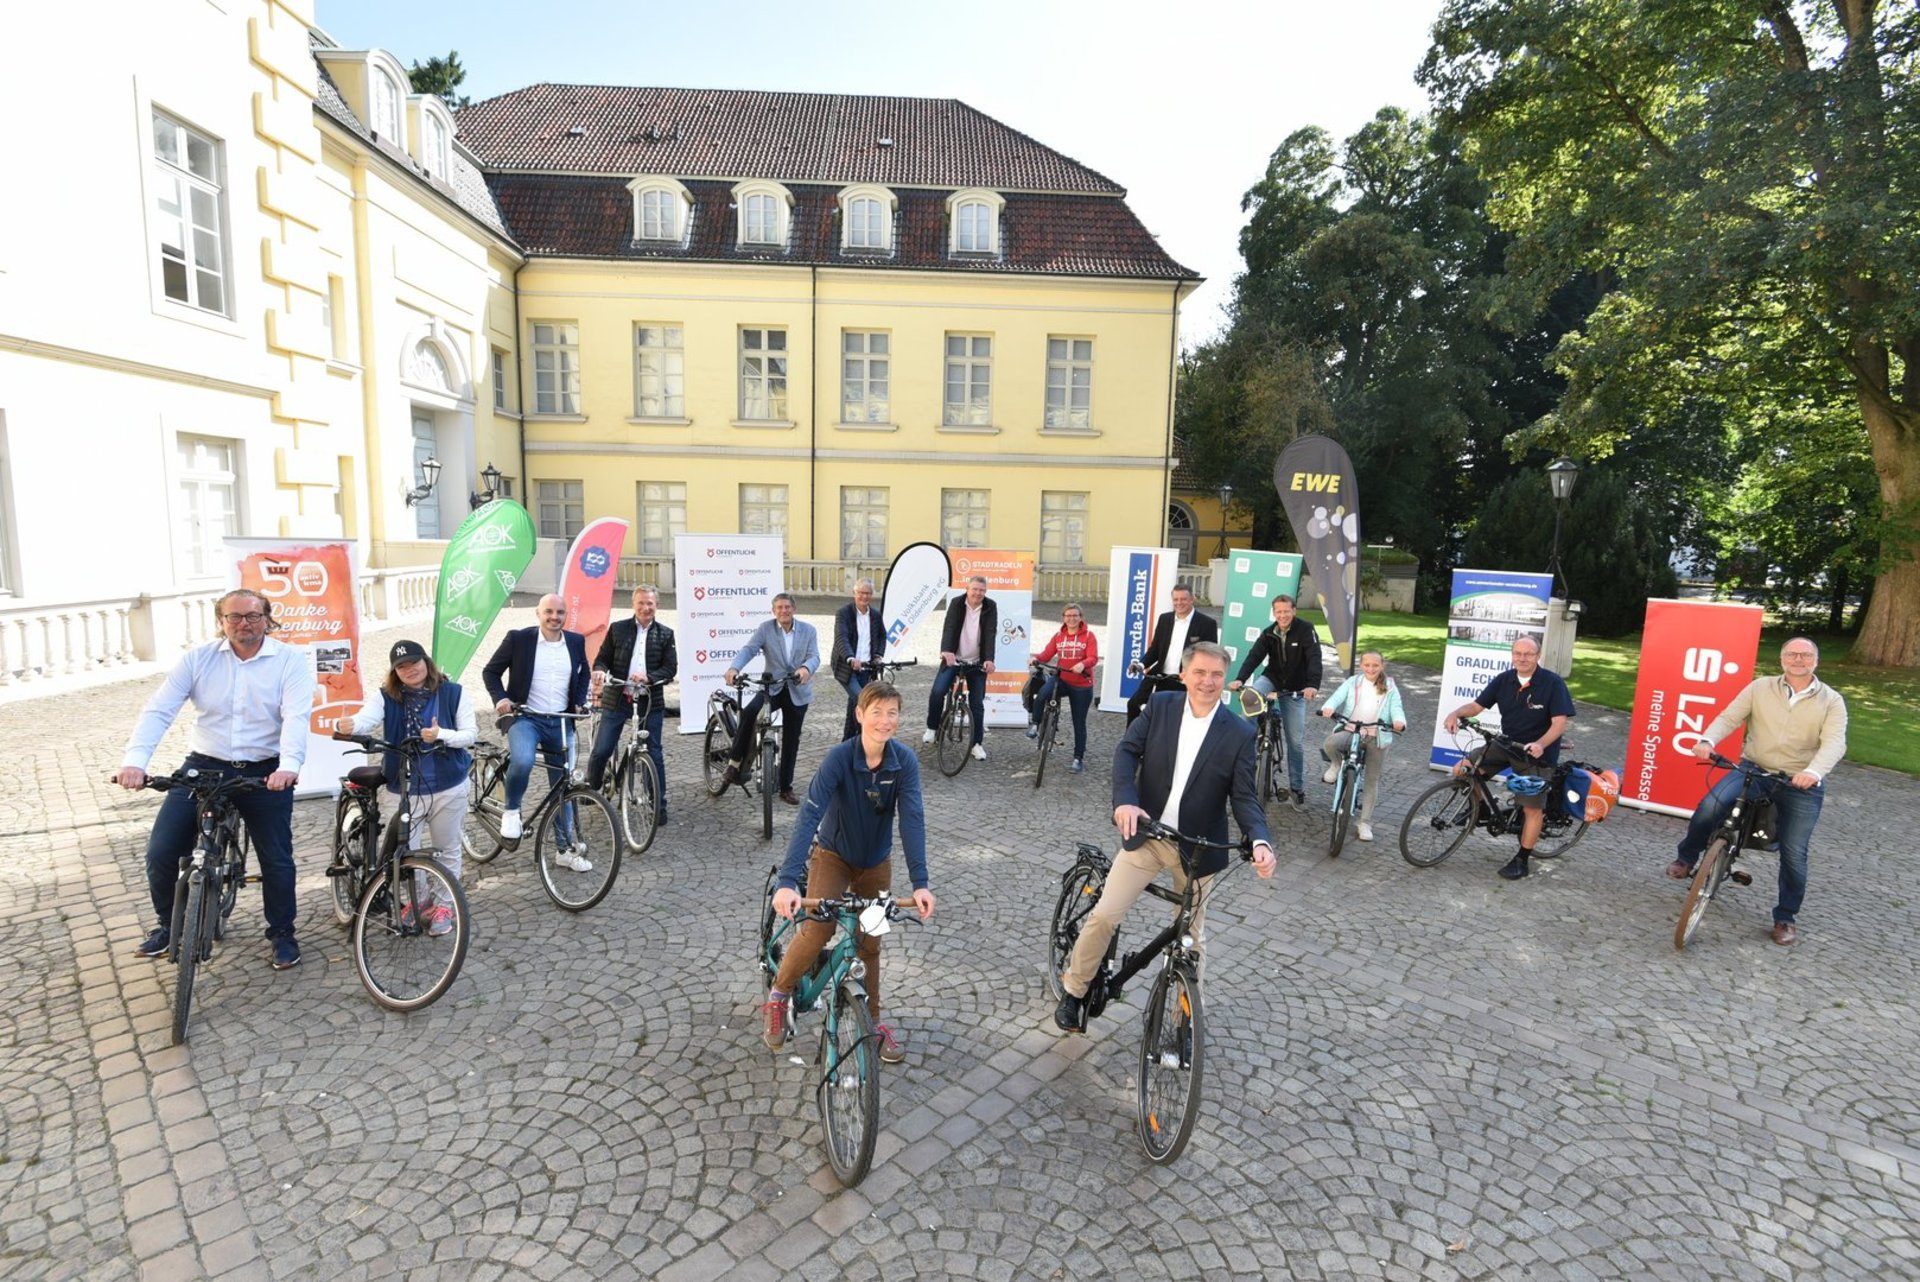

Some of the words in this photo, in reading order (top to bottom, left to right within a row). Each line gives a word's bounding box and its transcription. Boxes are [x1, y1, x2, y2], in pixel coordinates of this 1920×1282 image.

[1290, 472, 1341, 493] EWE
[467, 523, 516, 549] AOK
[715, 548, 756, 556] ÖFFENTLICHE
[971, 561, 1022, 569] STADTRADELN
[259, 561, 328, 598] 50
[446, 562, 481, 601] AOK
[985, 576, 1020, 586] enburg
[707, 586, 768, 596] ÖFFENTLICHE
[901, 583, 930, 618] Volksbank
[270, 602, 328, 618] Danke
[907, 588, 939, 625] Oldenburg
[278, 618, 344, 636] enburg
[447, 614, 482, 635] AOK
[1472, 672, 1496, 685] ECH
[1648, 690, 1665, 732] meine
[1638, 735, 1661, 801] Sparkasse
